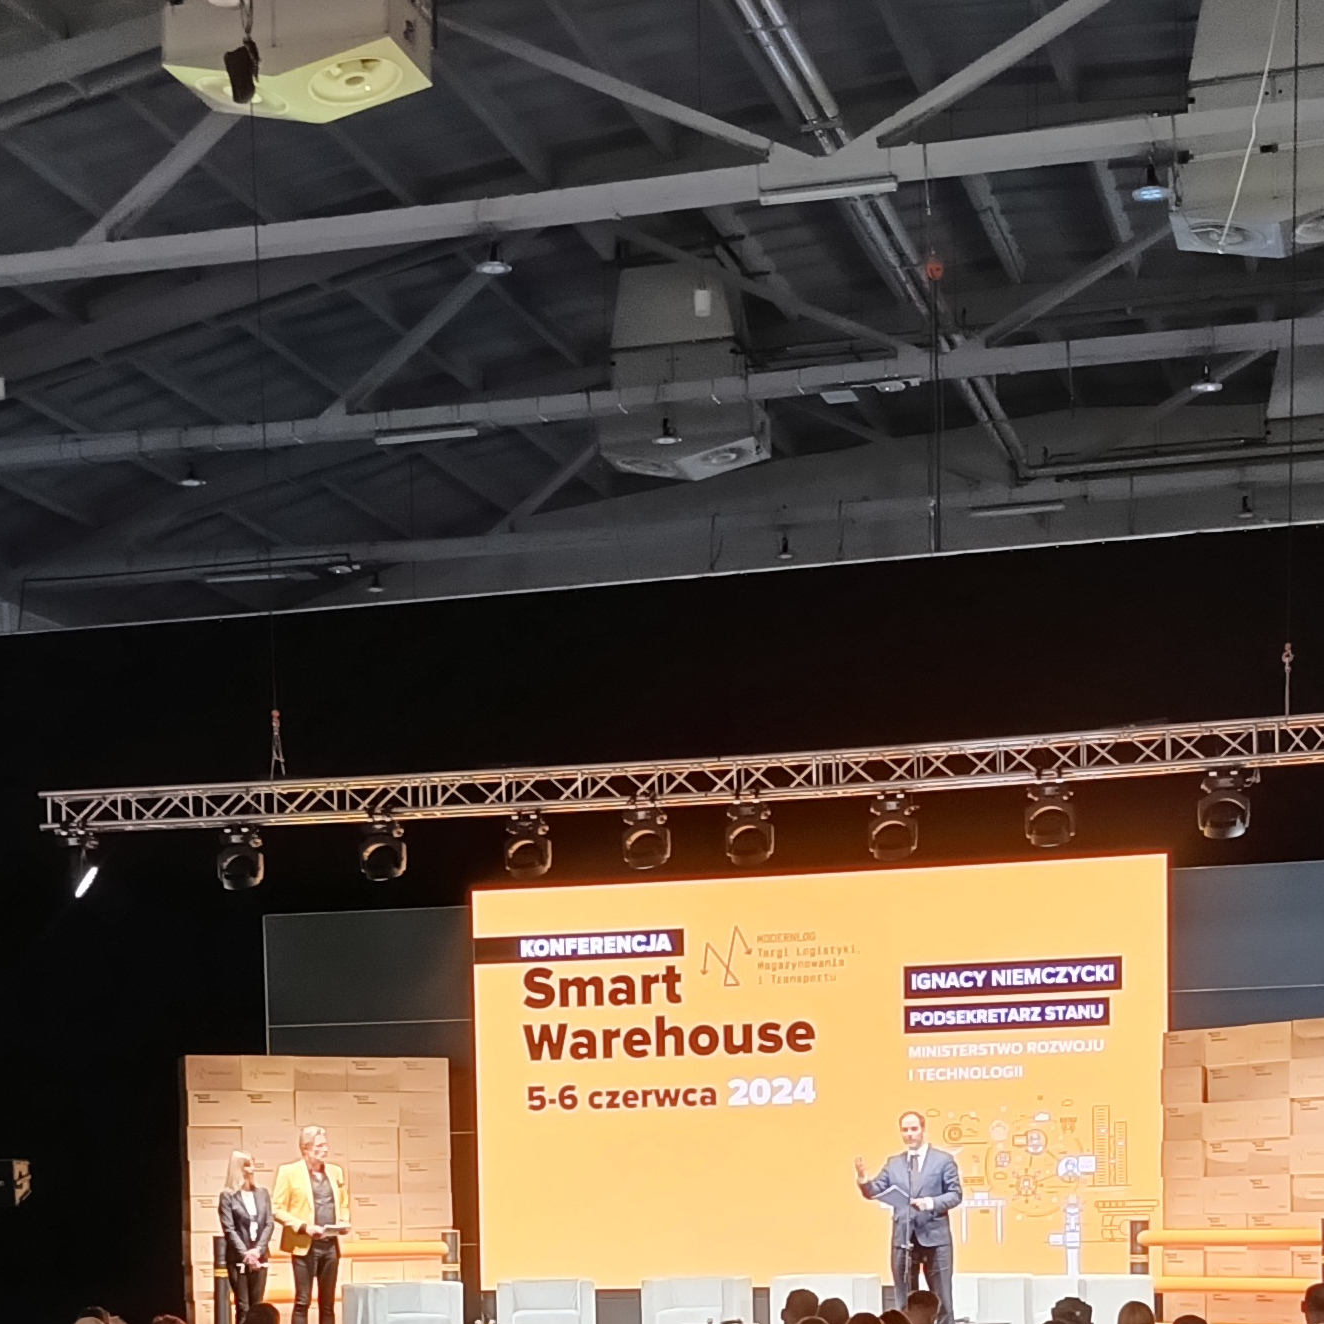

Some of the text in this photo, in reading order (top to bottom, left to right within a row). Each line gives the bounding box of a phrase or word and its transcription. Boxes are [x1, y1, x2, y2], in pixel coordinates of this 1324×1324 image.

[520, 933, 673, 958] KONFERENCJA
[758, 947, 788, 959] Targi
[523, 965, 683, 1009] Smart
[772, 974, 837, 984] Transportu
[911, 964, 1115, 990] IGNACY NIEMCZYCKI
[909, 1004, 1104, 1027] PODSEKRETARZ STANU
[522, 1015, 816, 1061] Warehouse
[908, 1039, 1105, 1059] MINISTERSTWO ROZWOJU
[917, 1065, 1024, 1082] TECHNOLOGII
[527, 1076, 816, 1111] 5-6 czerwca 2024
